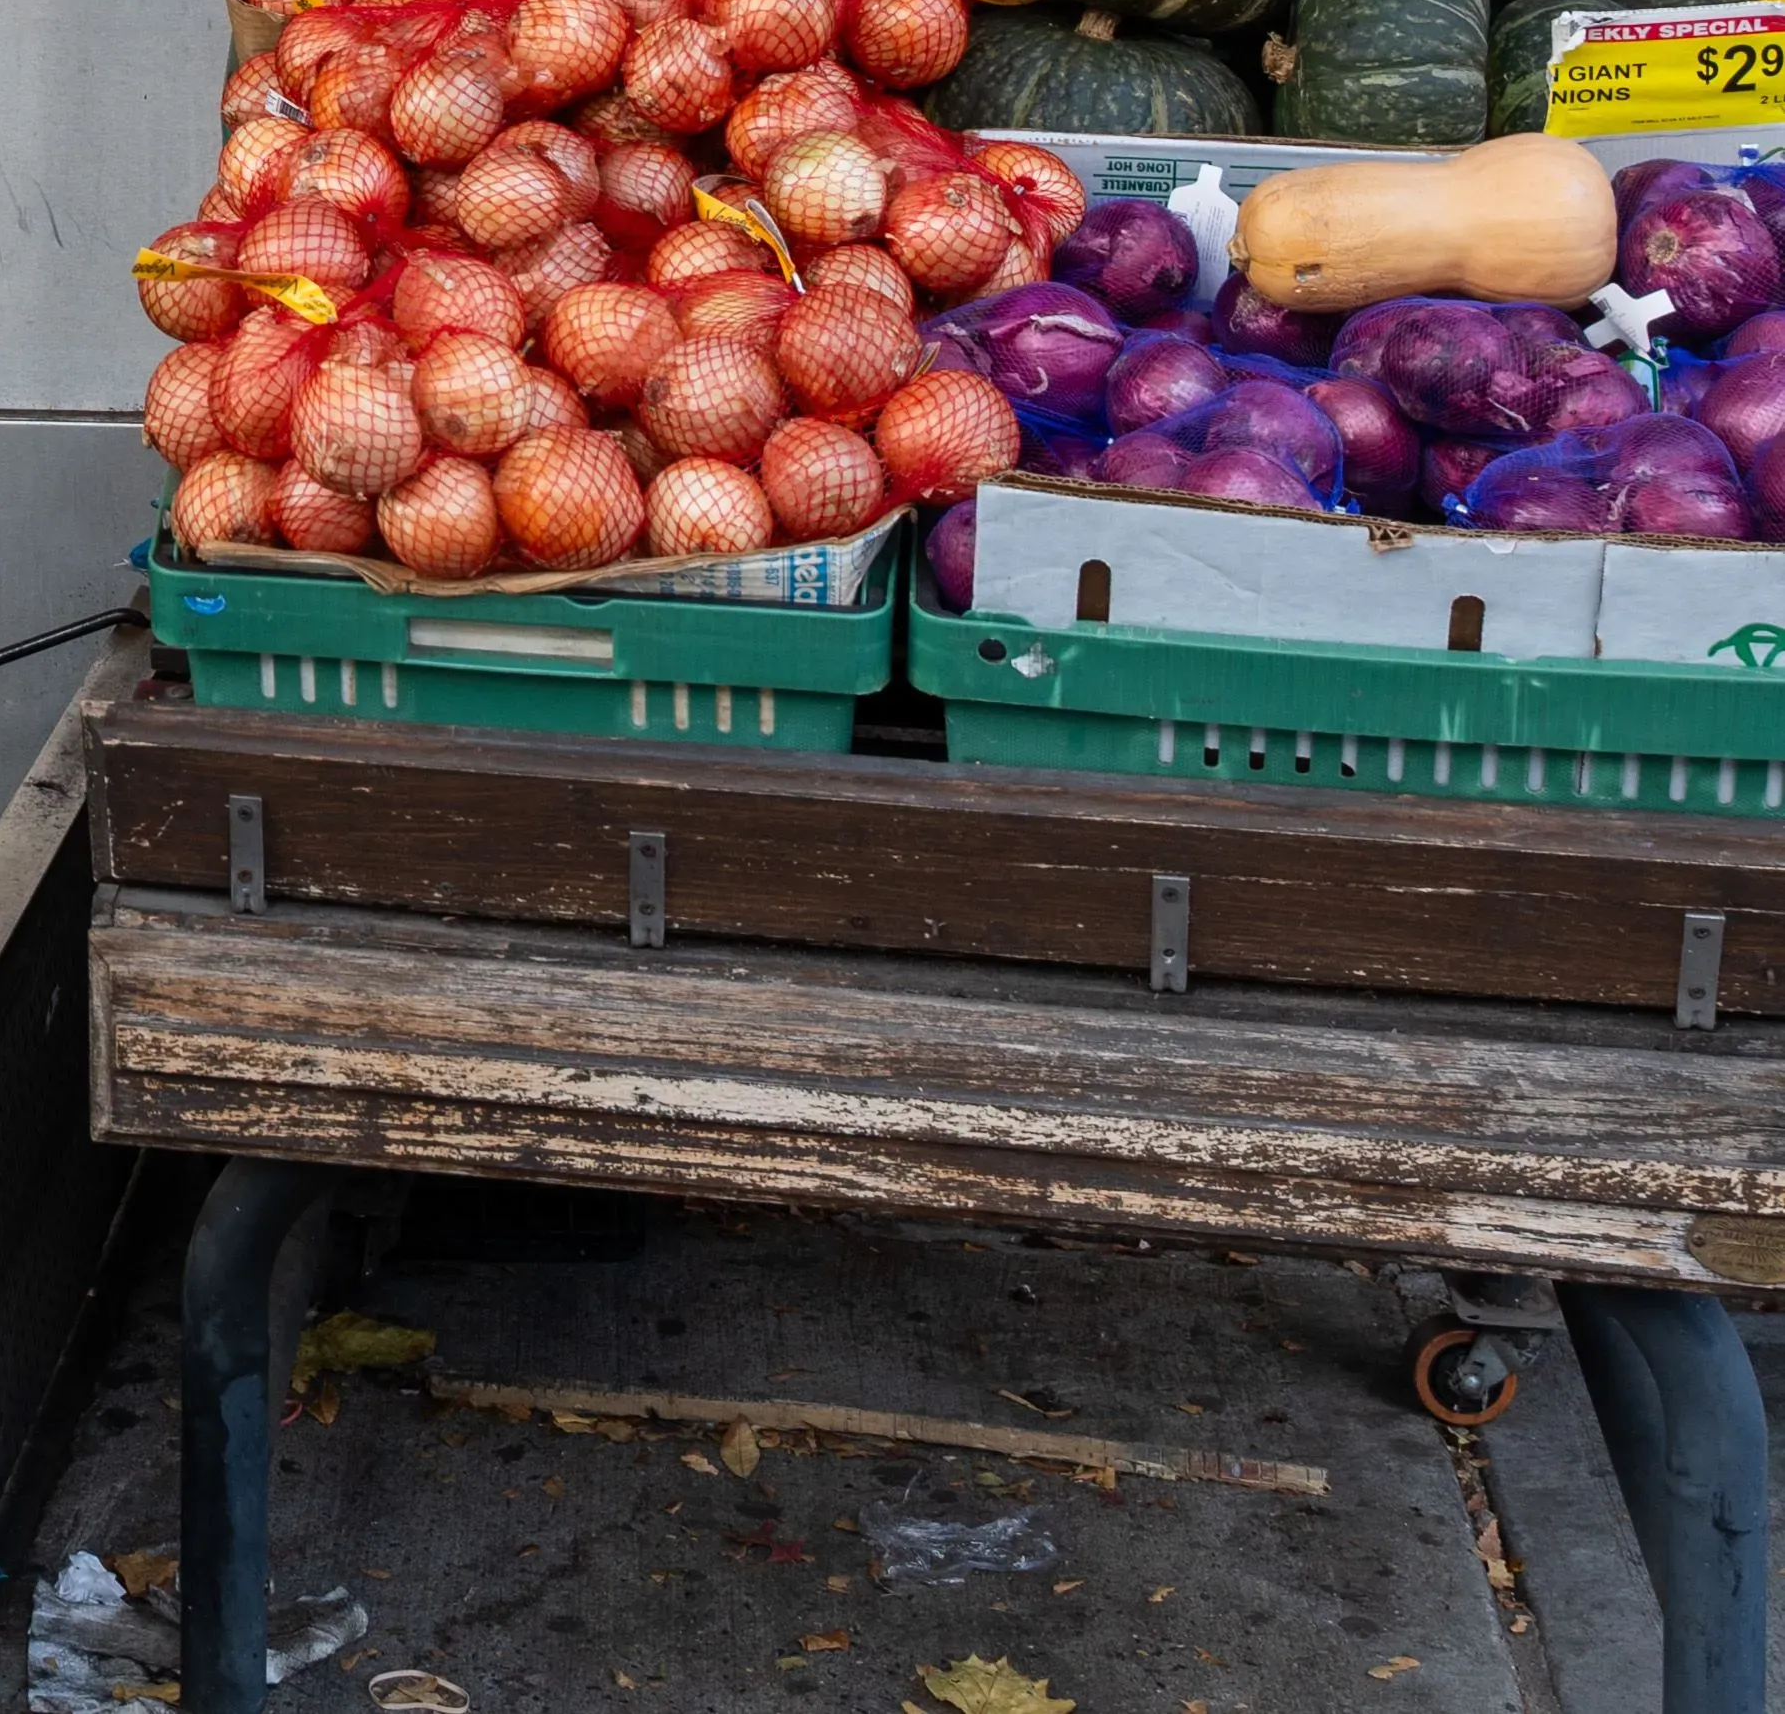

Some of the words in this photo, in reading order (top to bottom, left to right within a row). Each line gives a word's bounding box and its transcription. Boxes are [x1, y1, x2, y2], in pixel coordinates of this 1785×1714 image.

[1588, 25, 1652, 42] EKLY
[1659, 18, 1770, 38] SPECIAL
[1568, 63, 1648, 83] GIANT
[1551, 87, 1631, 105] NIONS
[1106, 160, 1133, 172] HOT
[1137, 161, 1172, 174] LONG
[1101, 178, 1171, 193] CUBANELLE
